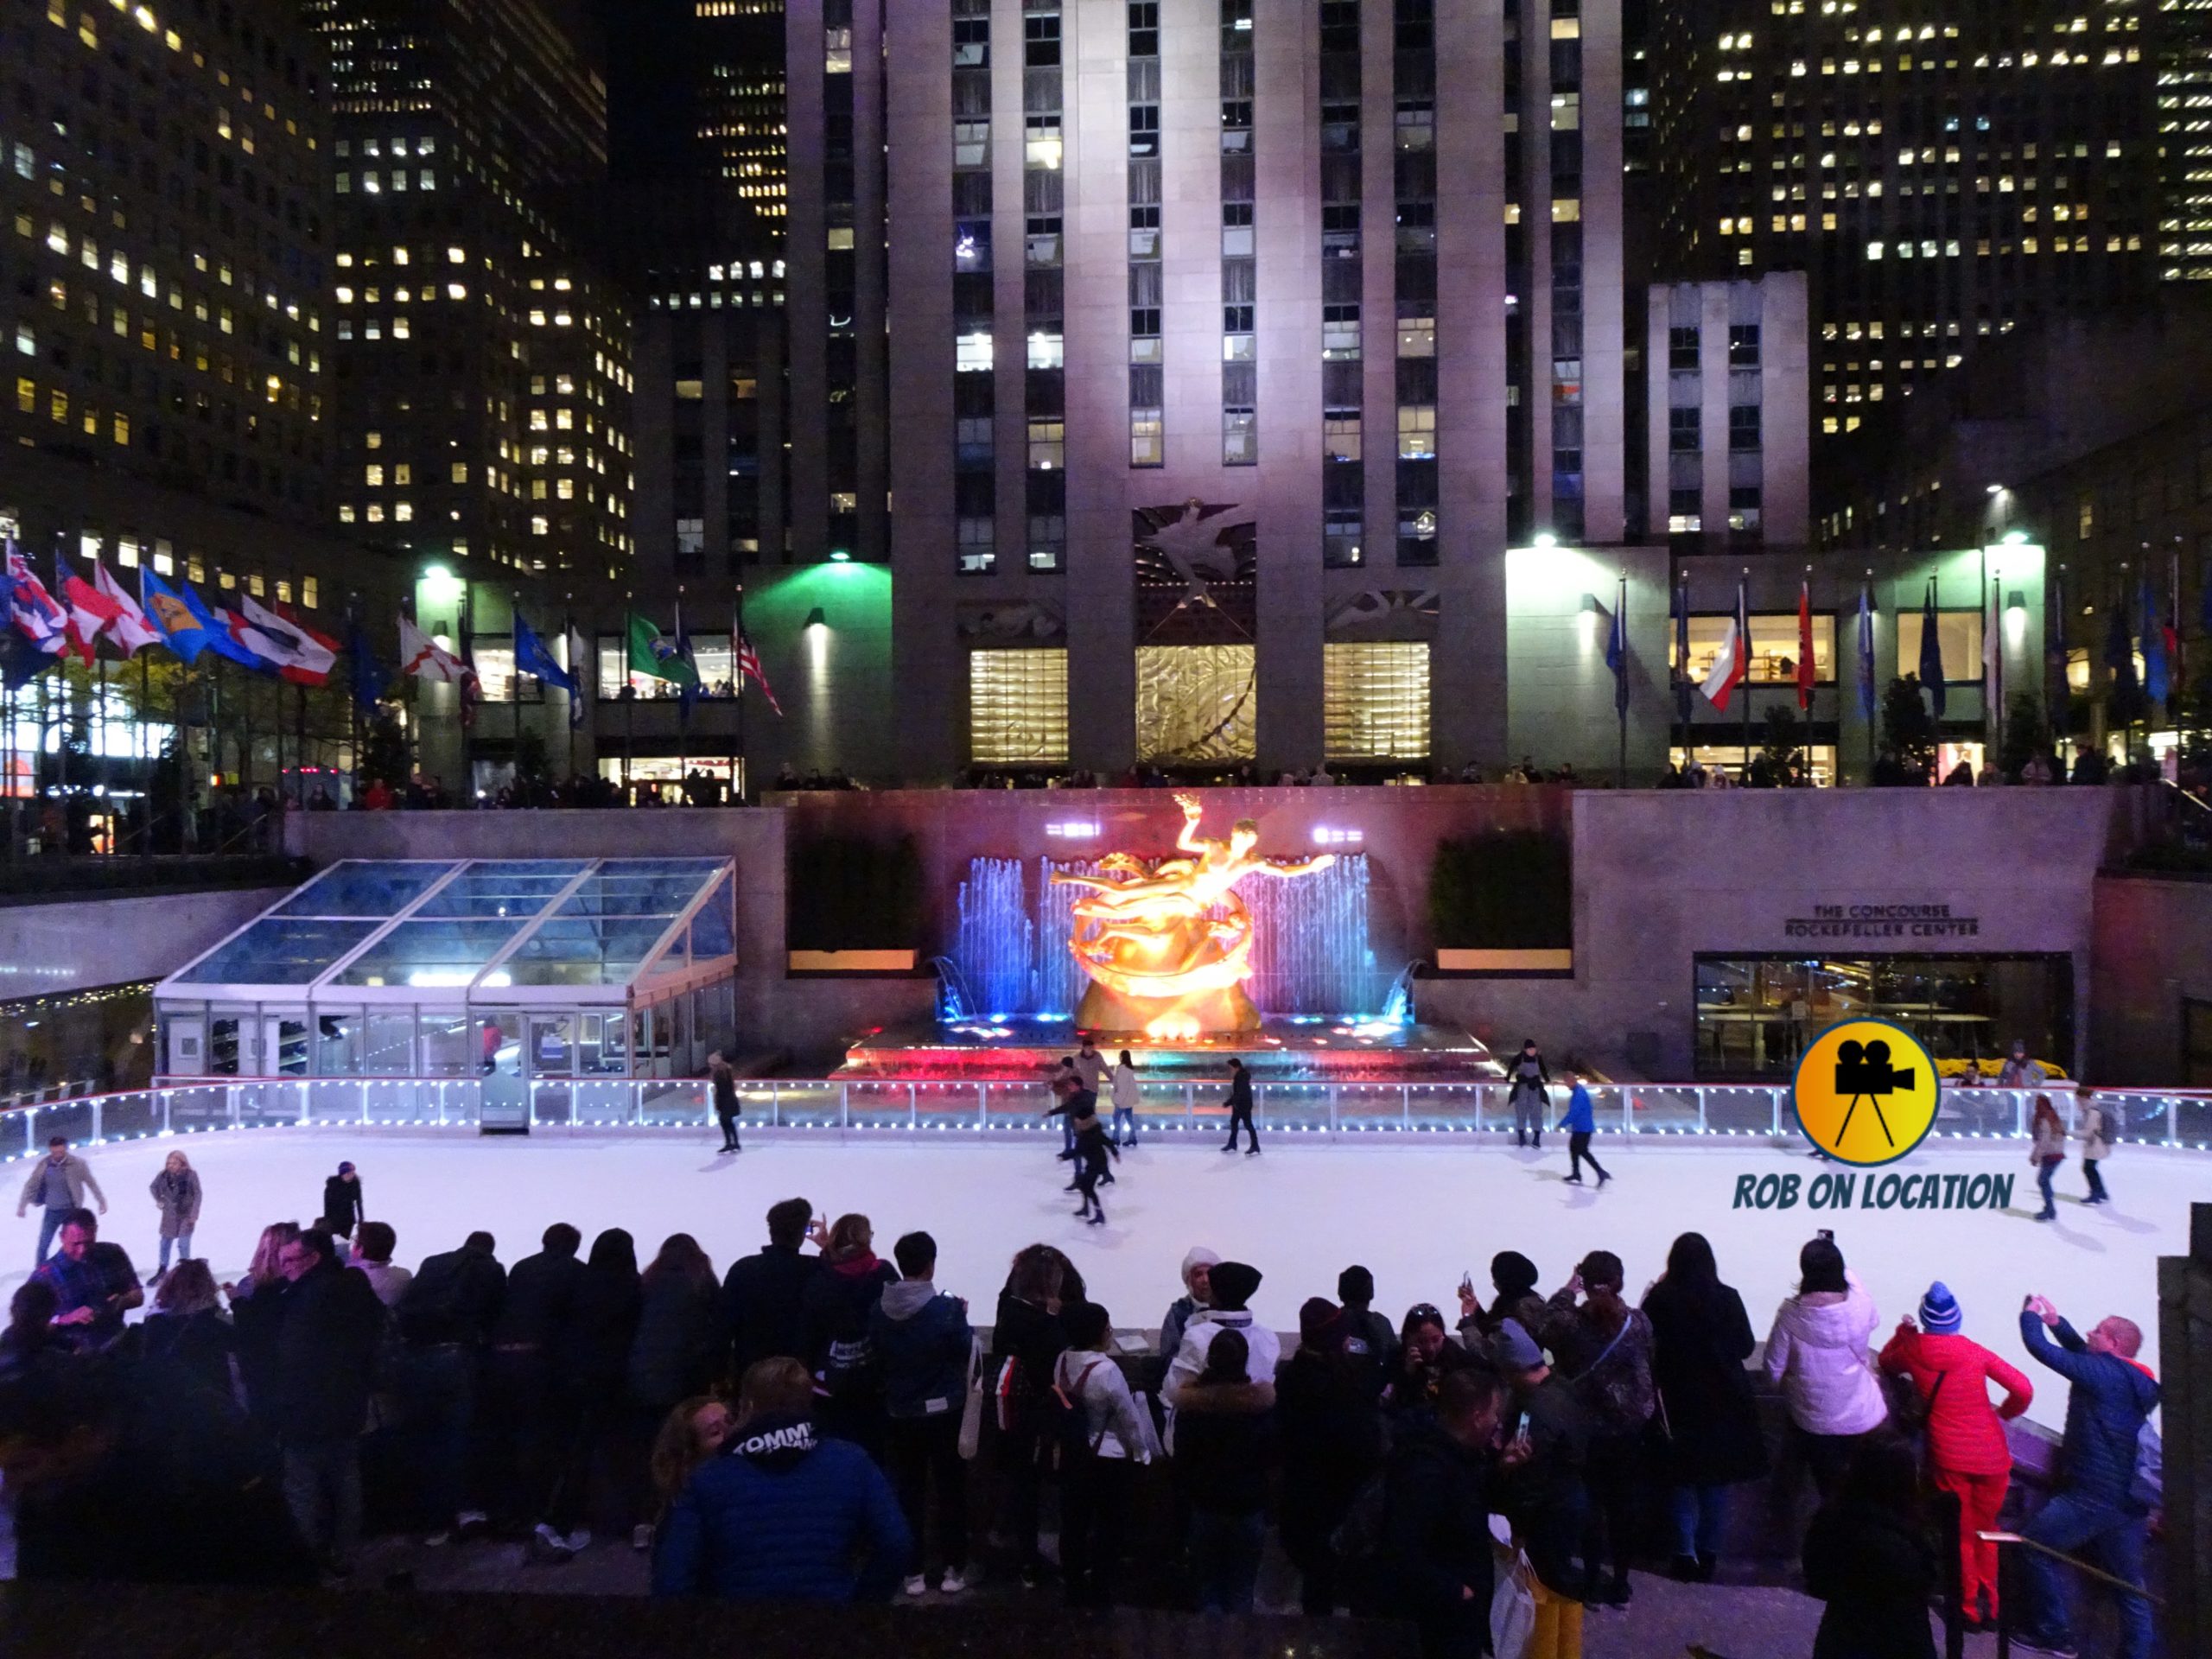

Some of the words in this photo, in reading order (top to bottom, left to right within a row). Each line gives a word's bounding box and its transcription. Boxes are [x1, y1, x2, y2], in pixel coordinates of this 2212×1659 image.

[1815, 905, 1842, 918] THE
[1849, 905, 1950, 918] CONCOURSE
[1785, 924, 1904, 937] ROCKEFELLER
[1911, 924, 1979, 937] CENTER
